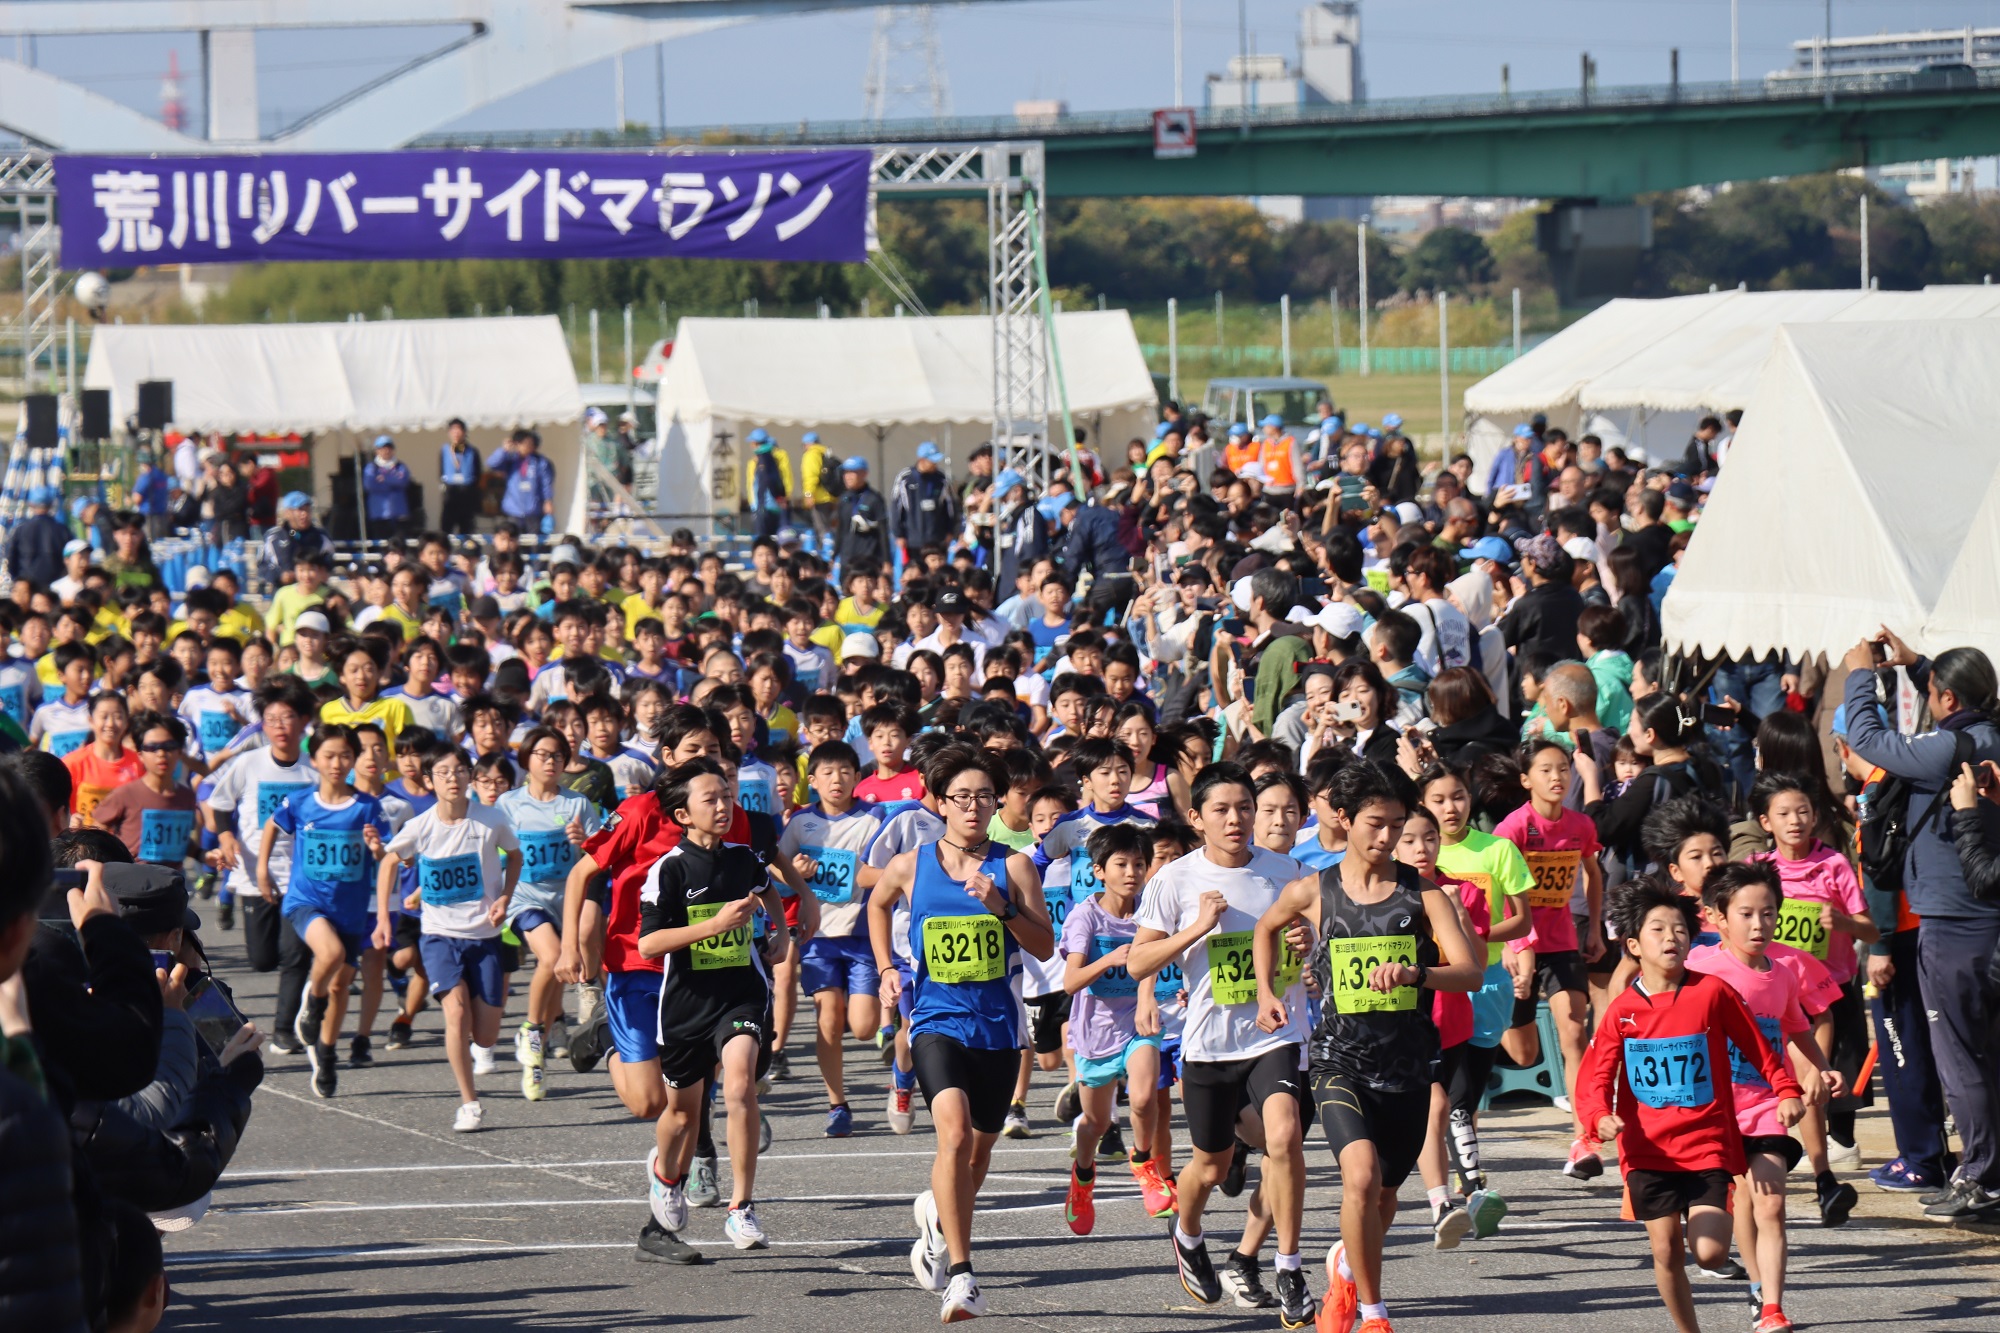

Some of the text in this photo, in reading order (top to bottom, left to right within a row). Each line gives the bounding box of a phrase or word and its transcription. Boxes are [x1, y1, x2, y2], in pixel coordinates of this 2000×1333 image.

[92, 167, 833, 253] 荒川リバーサイドマラソン
[308, 842, 361, 865] B3103
[424, 865, 478, 892] A3085
[1076, 862, 1105, 888] A3
[931, 930, 1000, 963] A3218
[1634, 1052, 1707, 1087] A3172
